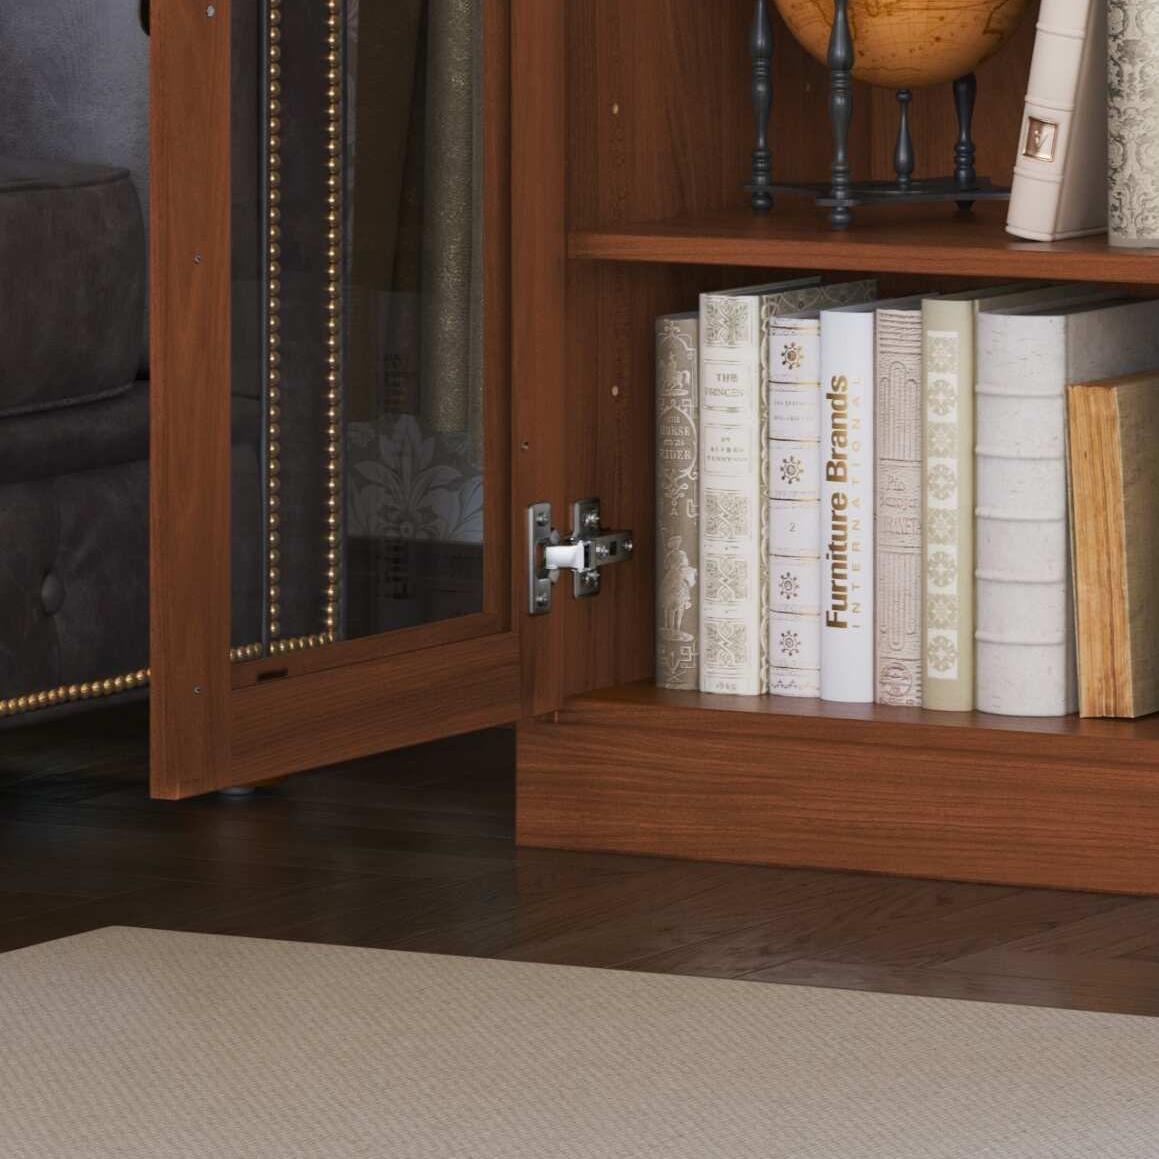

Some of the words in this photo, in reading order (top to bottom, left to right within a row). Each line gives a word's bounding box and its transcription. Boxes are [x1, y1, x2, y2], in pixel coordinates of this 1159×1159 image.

[716, 373, 738, 383] THE
[825, 374, 849, 483] Brands
[789, 522, 797, 533] 2
[851, 378, 861, 630] INTERNATIONAL
[825, 491, 849, 630] Furniture
